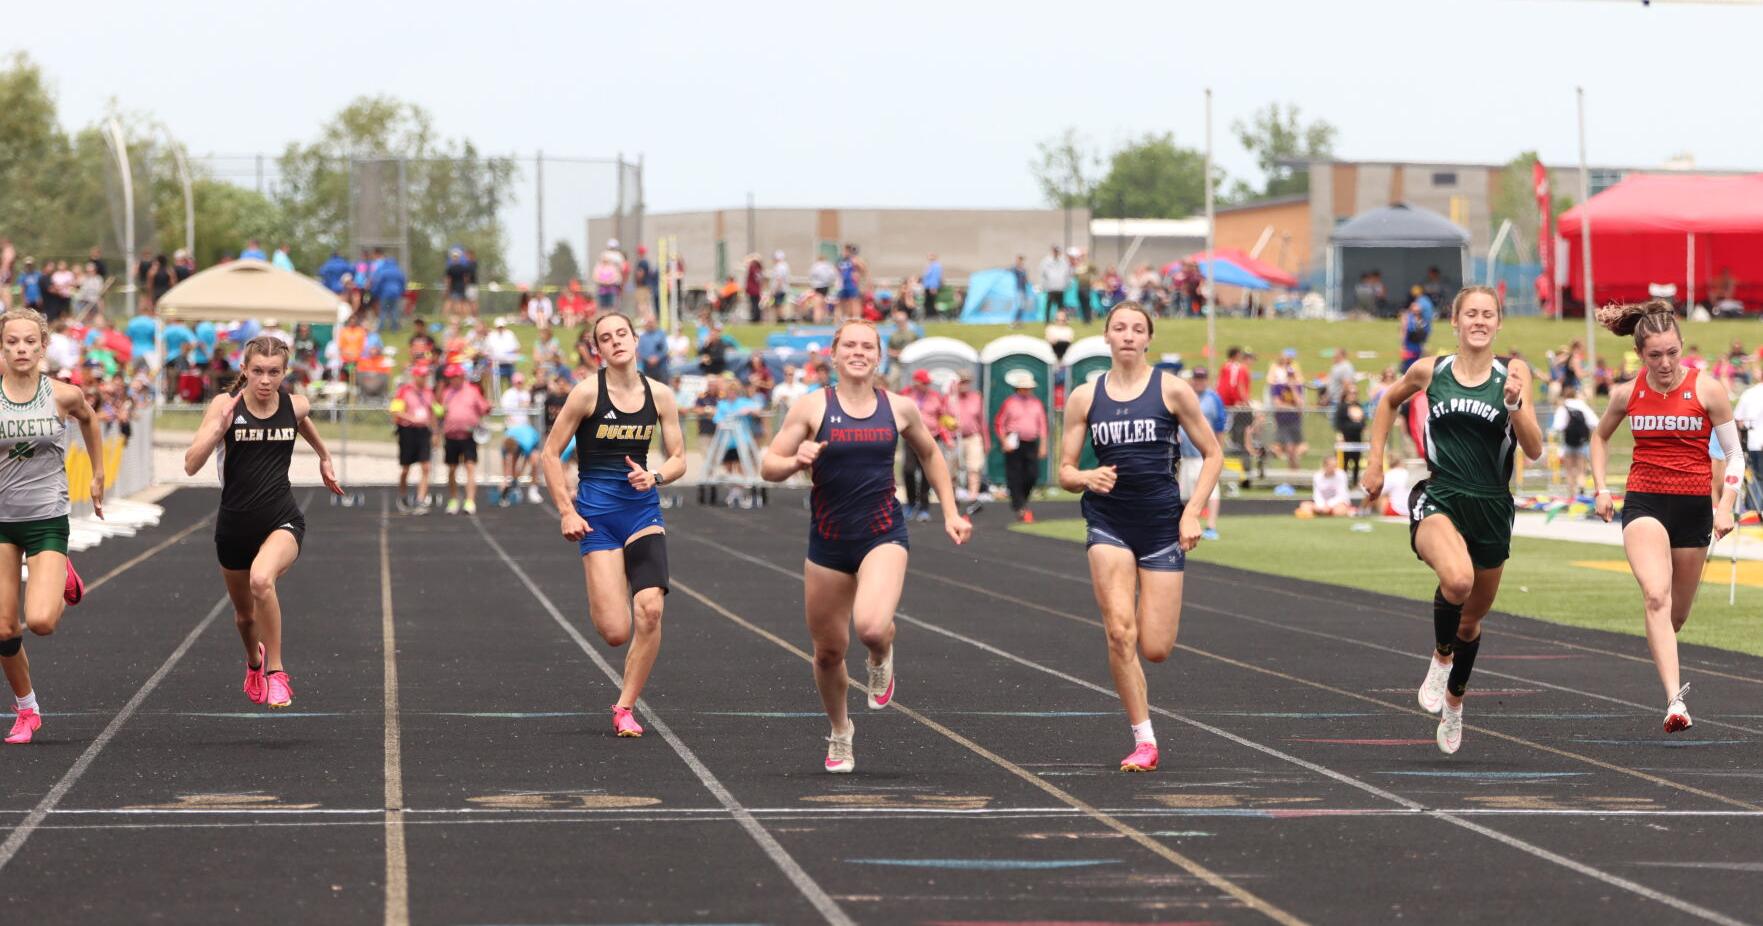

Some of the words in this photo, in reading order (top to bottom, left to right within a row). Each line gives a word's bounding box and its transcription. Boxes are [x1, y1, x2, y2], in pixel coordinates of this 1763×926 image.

[1432, 401, 1449, 418] ST.
[1450, 398, 1500, 423] PATRICK
[234, 428, 264, 442] GLEN
[266, 427, 295, 441] LAKE
[596, 424, 655, 440] BUCKLE
[830, 428, 893, 442] PATRIOTS
[1091, 420, 1157, 445] FOWLER
